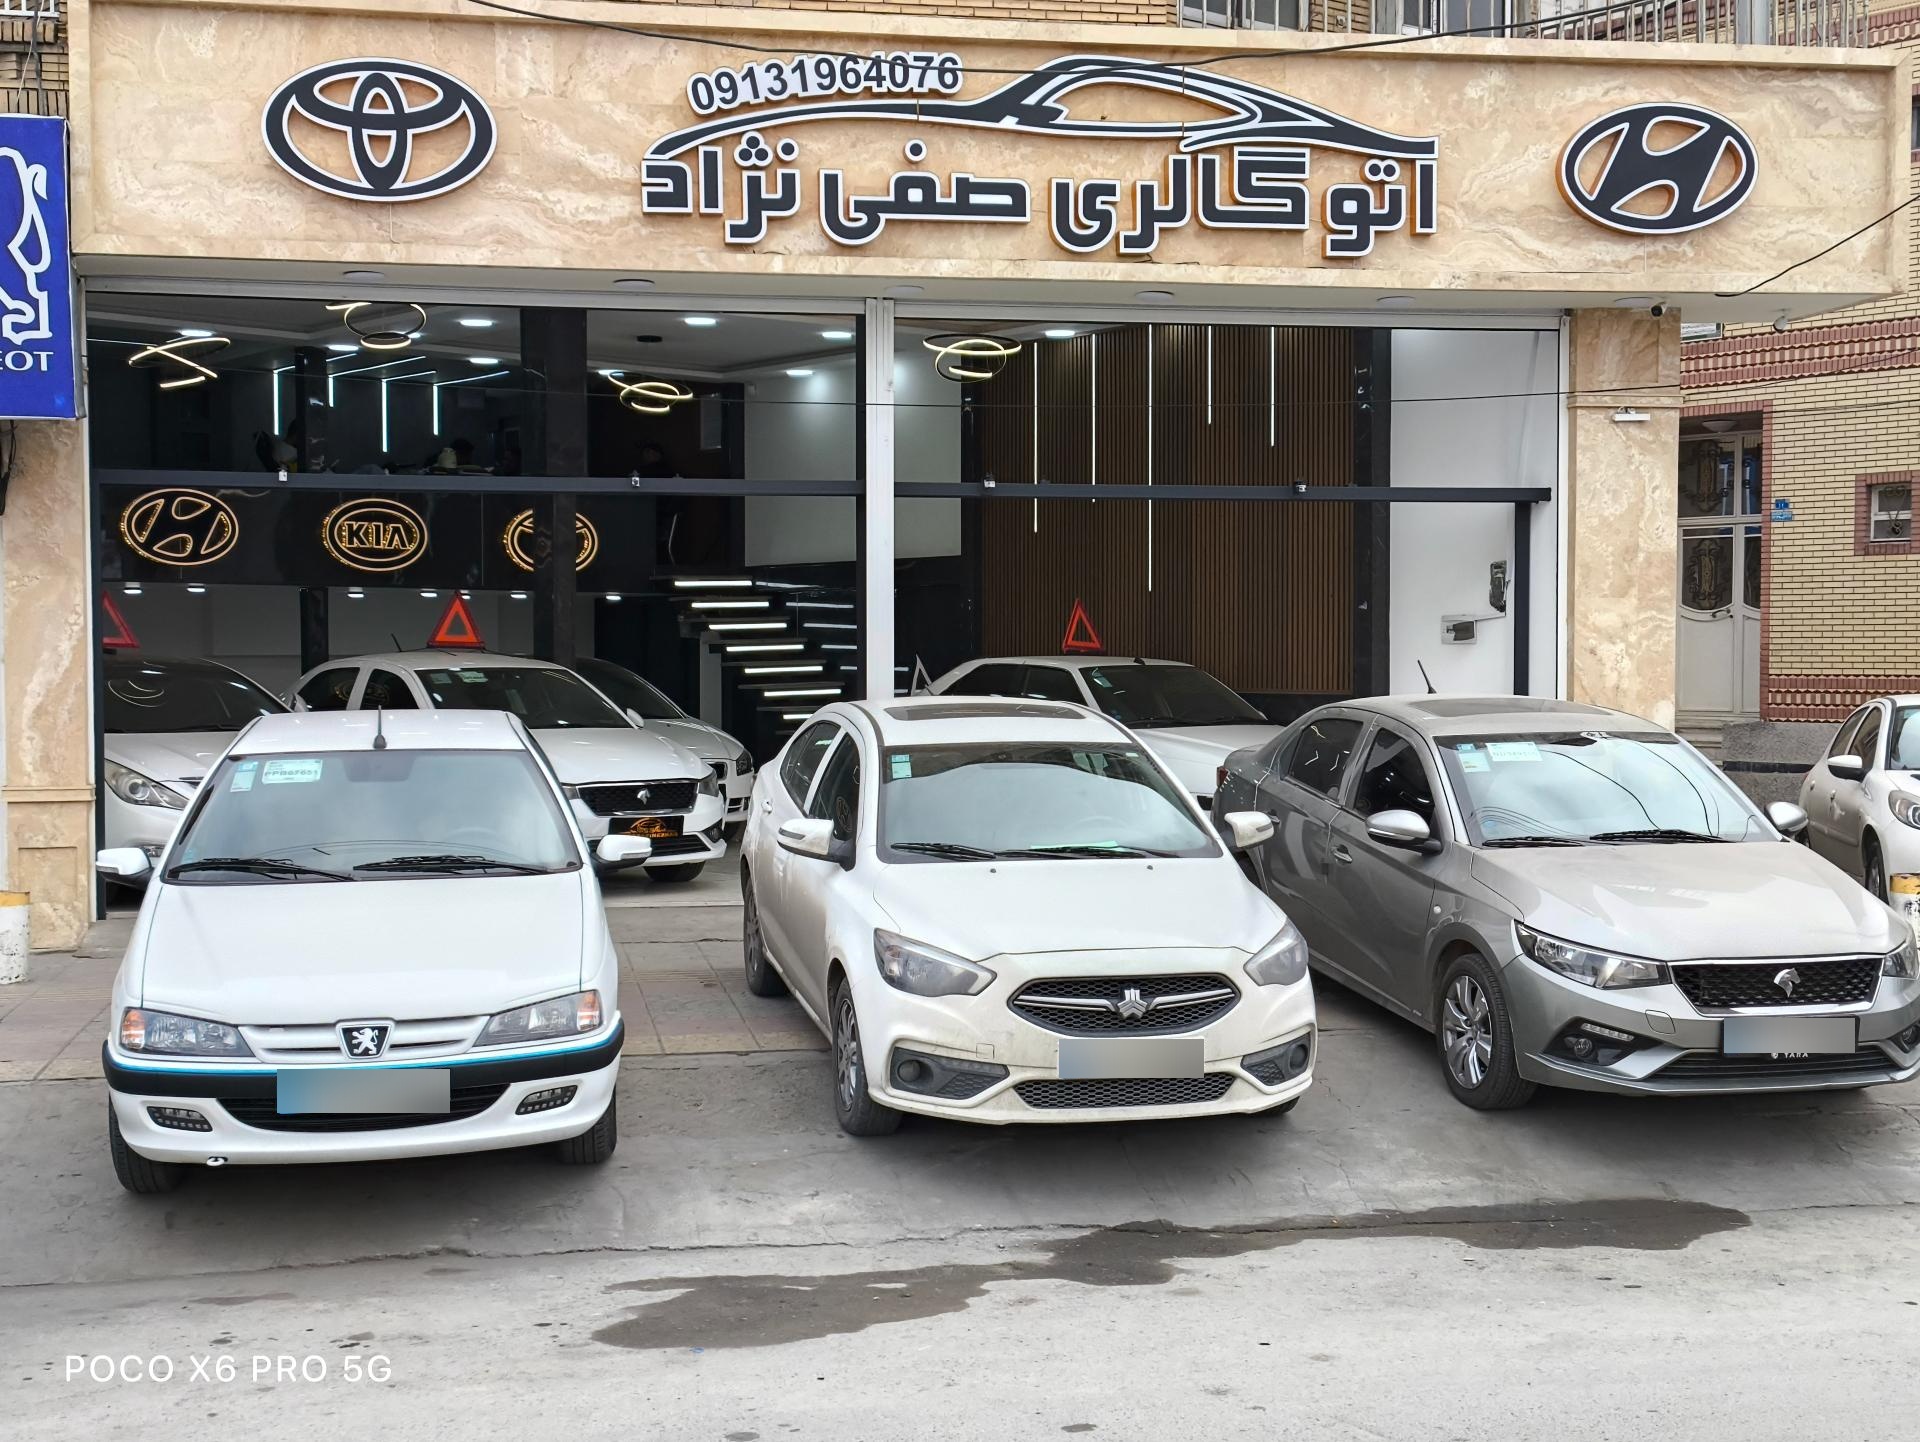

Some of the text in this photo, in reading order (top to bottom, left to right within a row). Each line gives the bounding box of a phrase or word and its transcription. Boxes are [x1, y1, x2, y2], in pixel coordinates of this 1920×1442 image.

[688, 52, 963, 115] 09131964076
[641, 130, 1438, 258] اتو گالری صفی نژاد
[0, 350, 54, 371] OT
[344, 521, 411, 550] KIA
